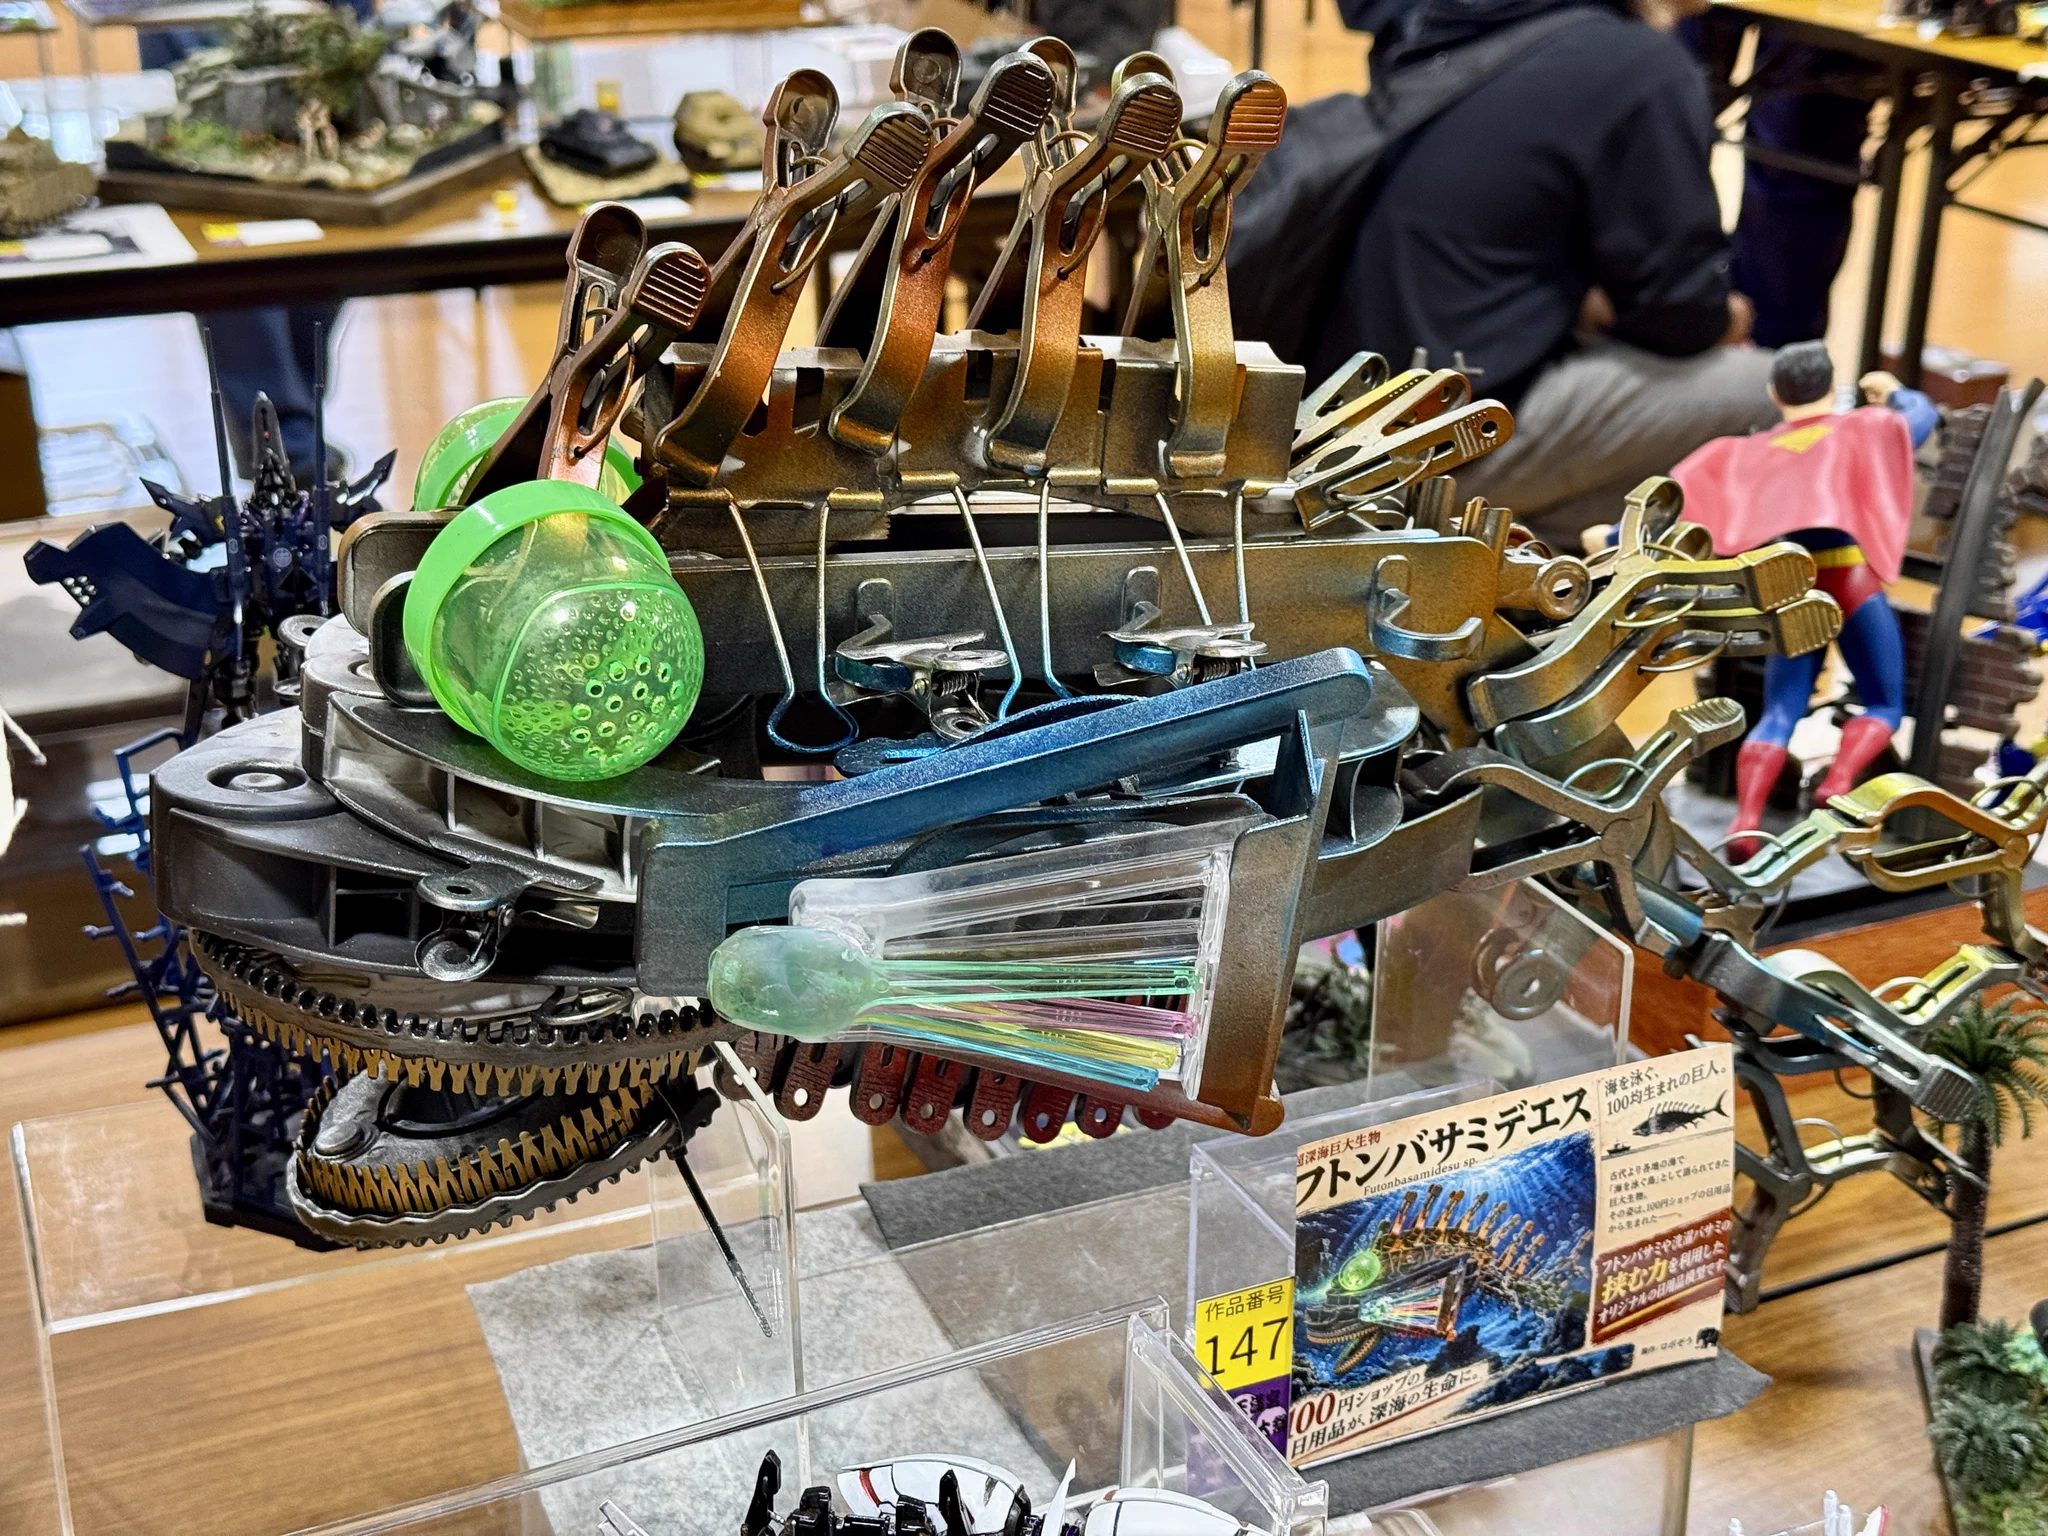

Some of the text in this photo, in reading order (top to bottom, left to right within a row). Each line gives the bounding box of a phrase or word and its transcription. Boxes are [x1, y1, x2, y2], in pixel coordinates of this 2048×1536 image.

[1604, 1066, 1660, 1097] 海を泳ぐ、
[1606, 1059, 1727, 1116] 100均生まれの巨人。
[1295, 1086, 1592, 1209] フトンバサミデエス
[1363, 1157, 1479, 1197] Futonbasamidesu sp.
[1601, 1239, 1726, 1306] 挟む力を利用した
[1205, 1284, 1285, 1323] 作品番号
[1205, 1316, 1289, 1377] 147
[1288, 1371, 1421, 1440] 100円ショップの
[1291, 1370, 1479, 1457] 日用品が、深海の生命に。
